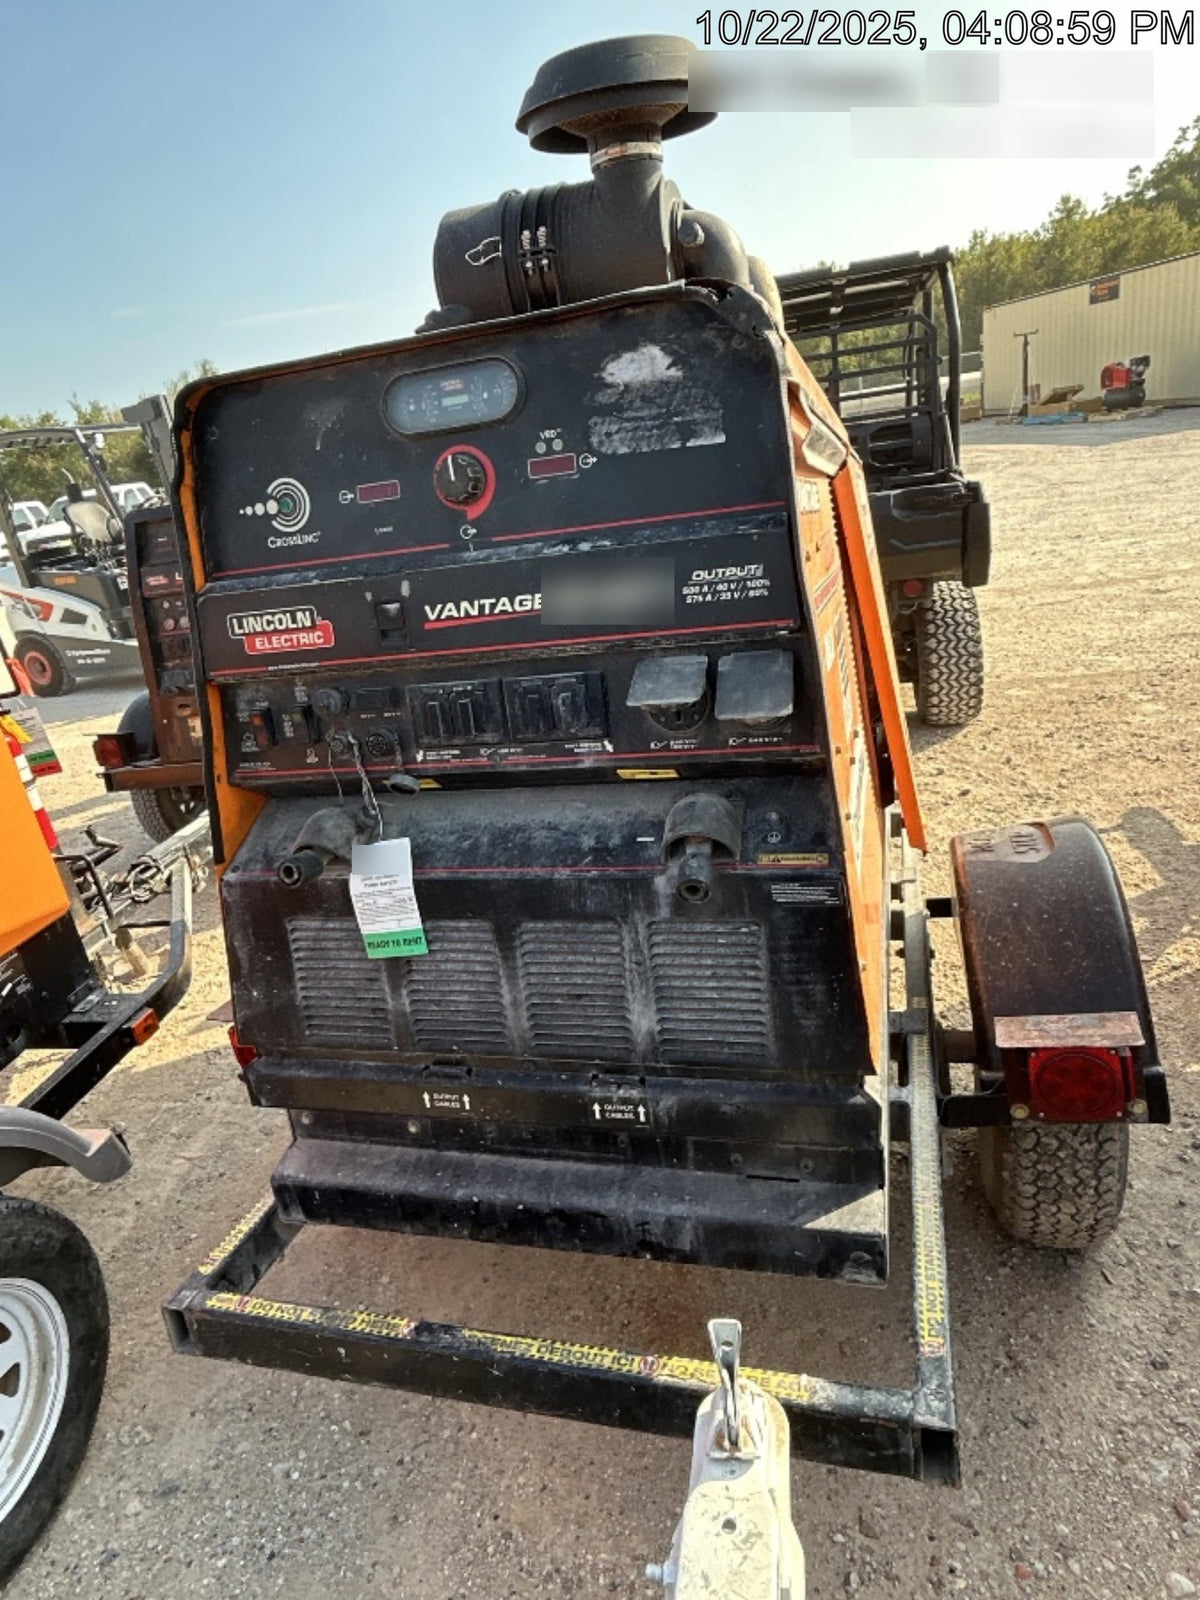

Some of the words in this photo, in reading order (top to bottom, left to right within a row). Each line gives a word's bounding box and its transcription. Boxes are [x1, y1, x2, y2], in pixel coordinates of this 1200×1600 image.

[691, 565, 758, 580] OUTPUT
[232, 611, 312, 634] LINCOLN
[255, 631, 324, 649] ELECTRIC
